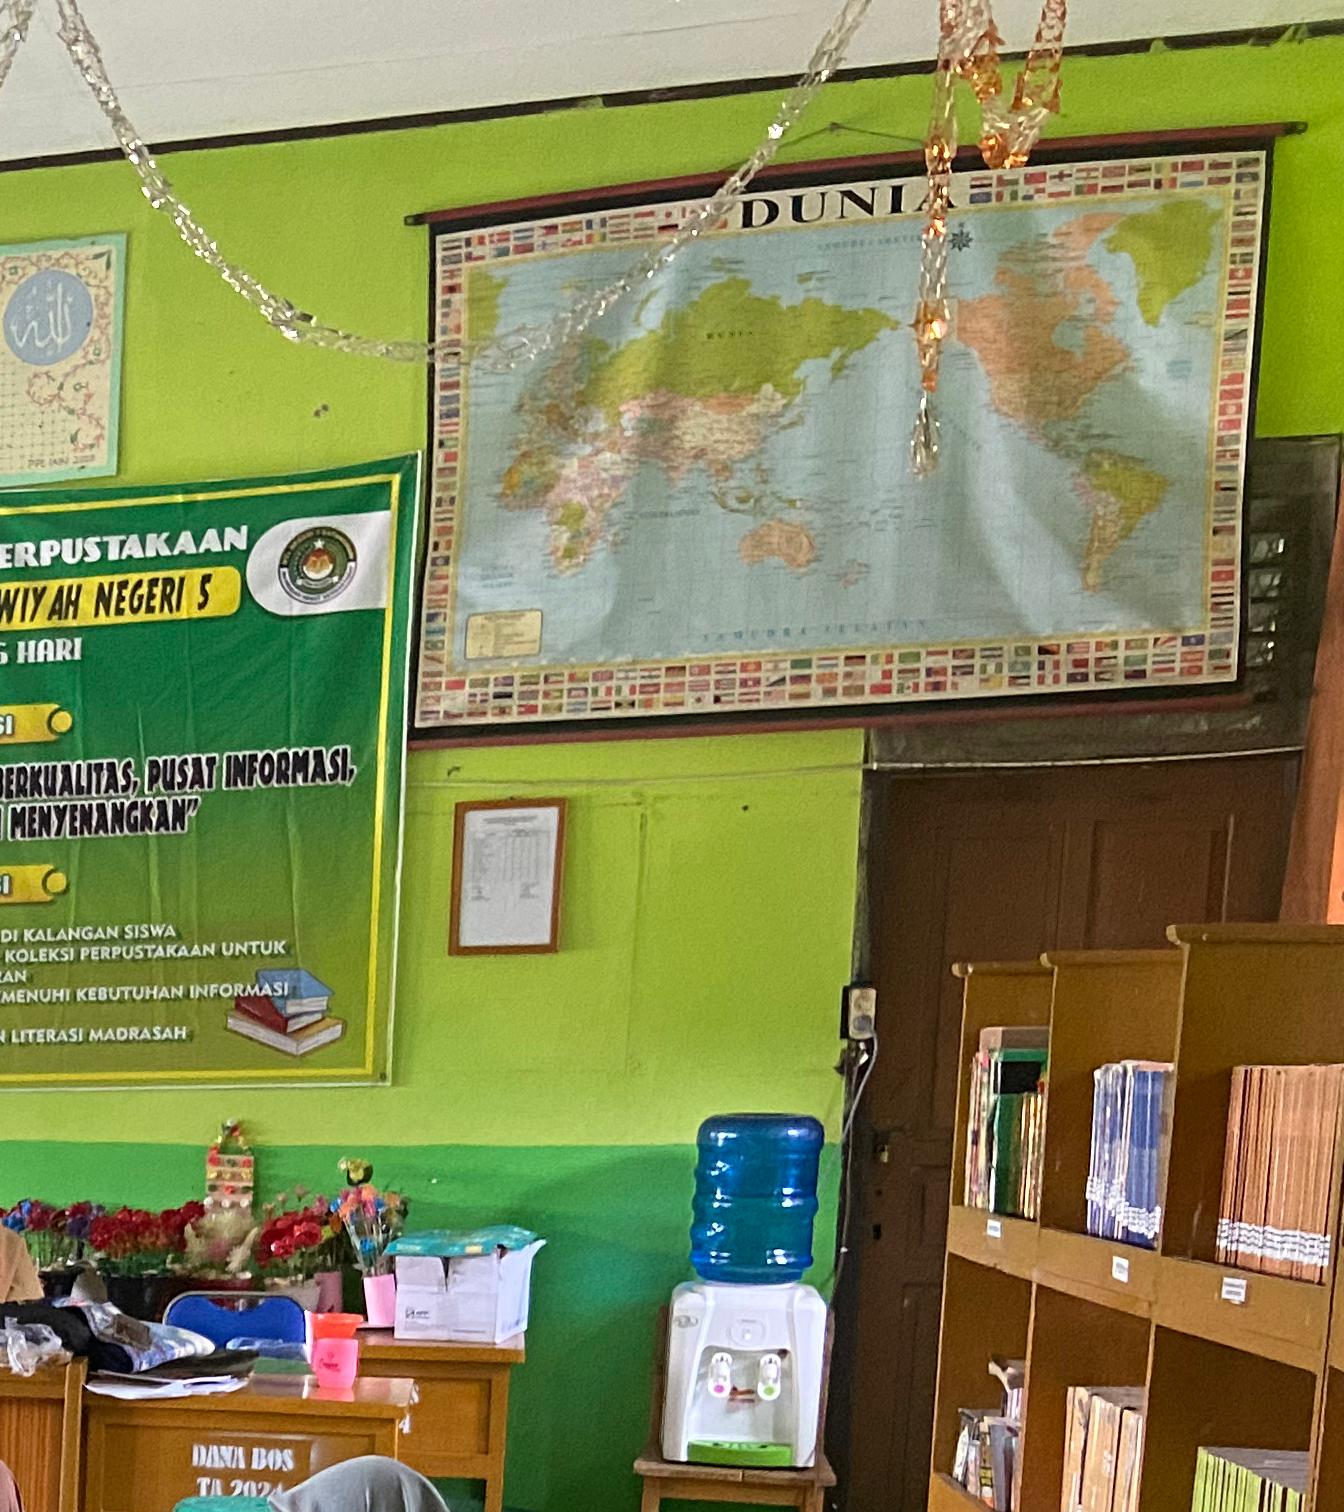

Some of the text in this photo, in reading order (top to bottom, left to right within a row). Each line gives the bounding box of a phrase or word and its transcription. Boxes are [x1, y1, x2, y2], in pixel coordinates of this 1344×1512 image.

[95, 576, 184, 618] NEGERI
[197, 572, 213, 612] 5
[17, 637, 82, 665] HARI
[145, 753, 218, 795] PUSAT
[222, 745, 357, 791] INFORMASI,
[0, 929, 18, 943] DI
[24, 926, 118, 942] KALANGAN
[124, 924, 177, 939] SISWA
[5, 947, 74, 963] KOLEKSI
[80, 943, 215, 961] PERPUSTAKAAN
[221, 940, 286, 956] UNTUK
[76, 985, 184, 1001] KEBUTUHAN
[189, 981, 289, 998] INFORMASI
[11, 1028, 83, 1043] LITERASI
[89, 1026, 187, 1042] MADRASAH
[192, 1443, 295, 1472] DANA BOS
[196, 1477, 222, 1497] TA
